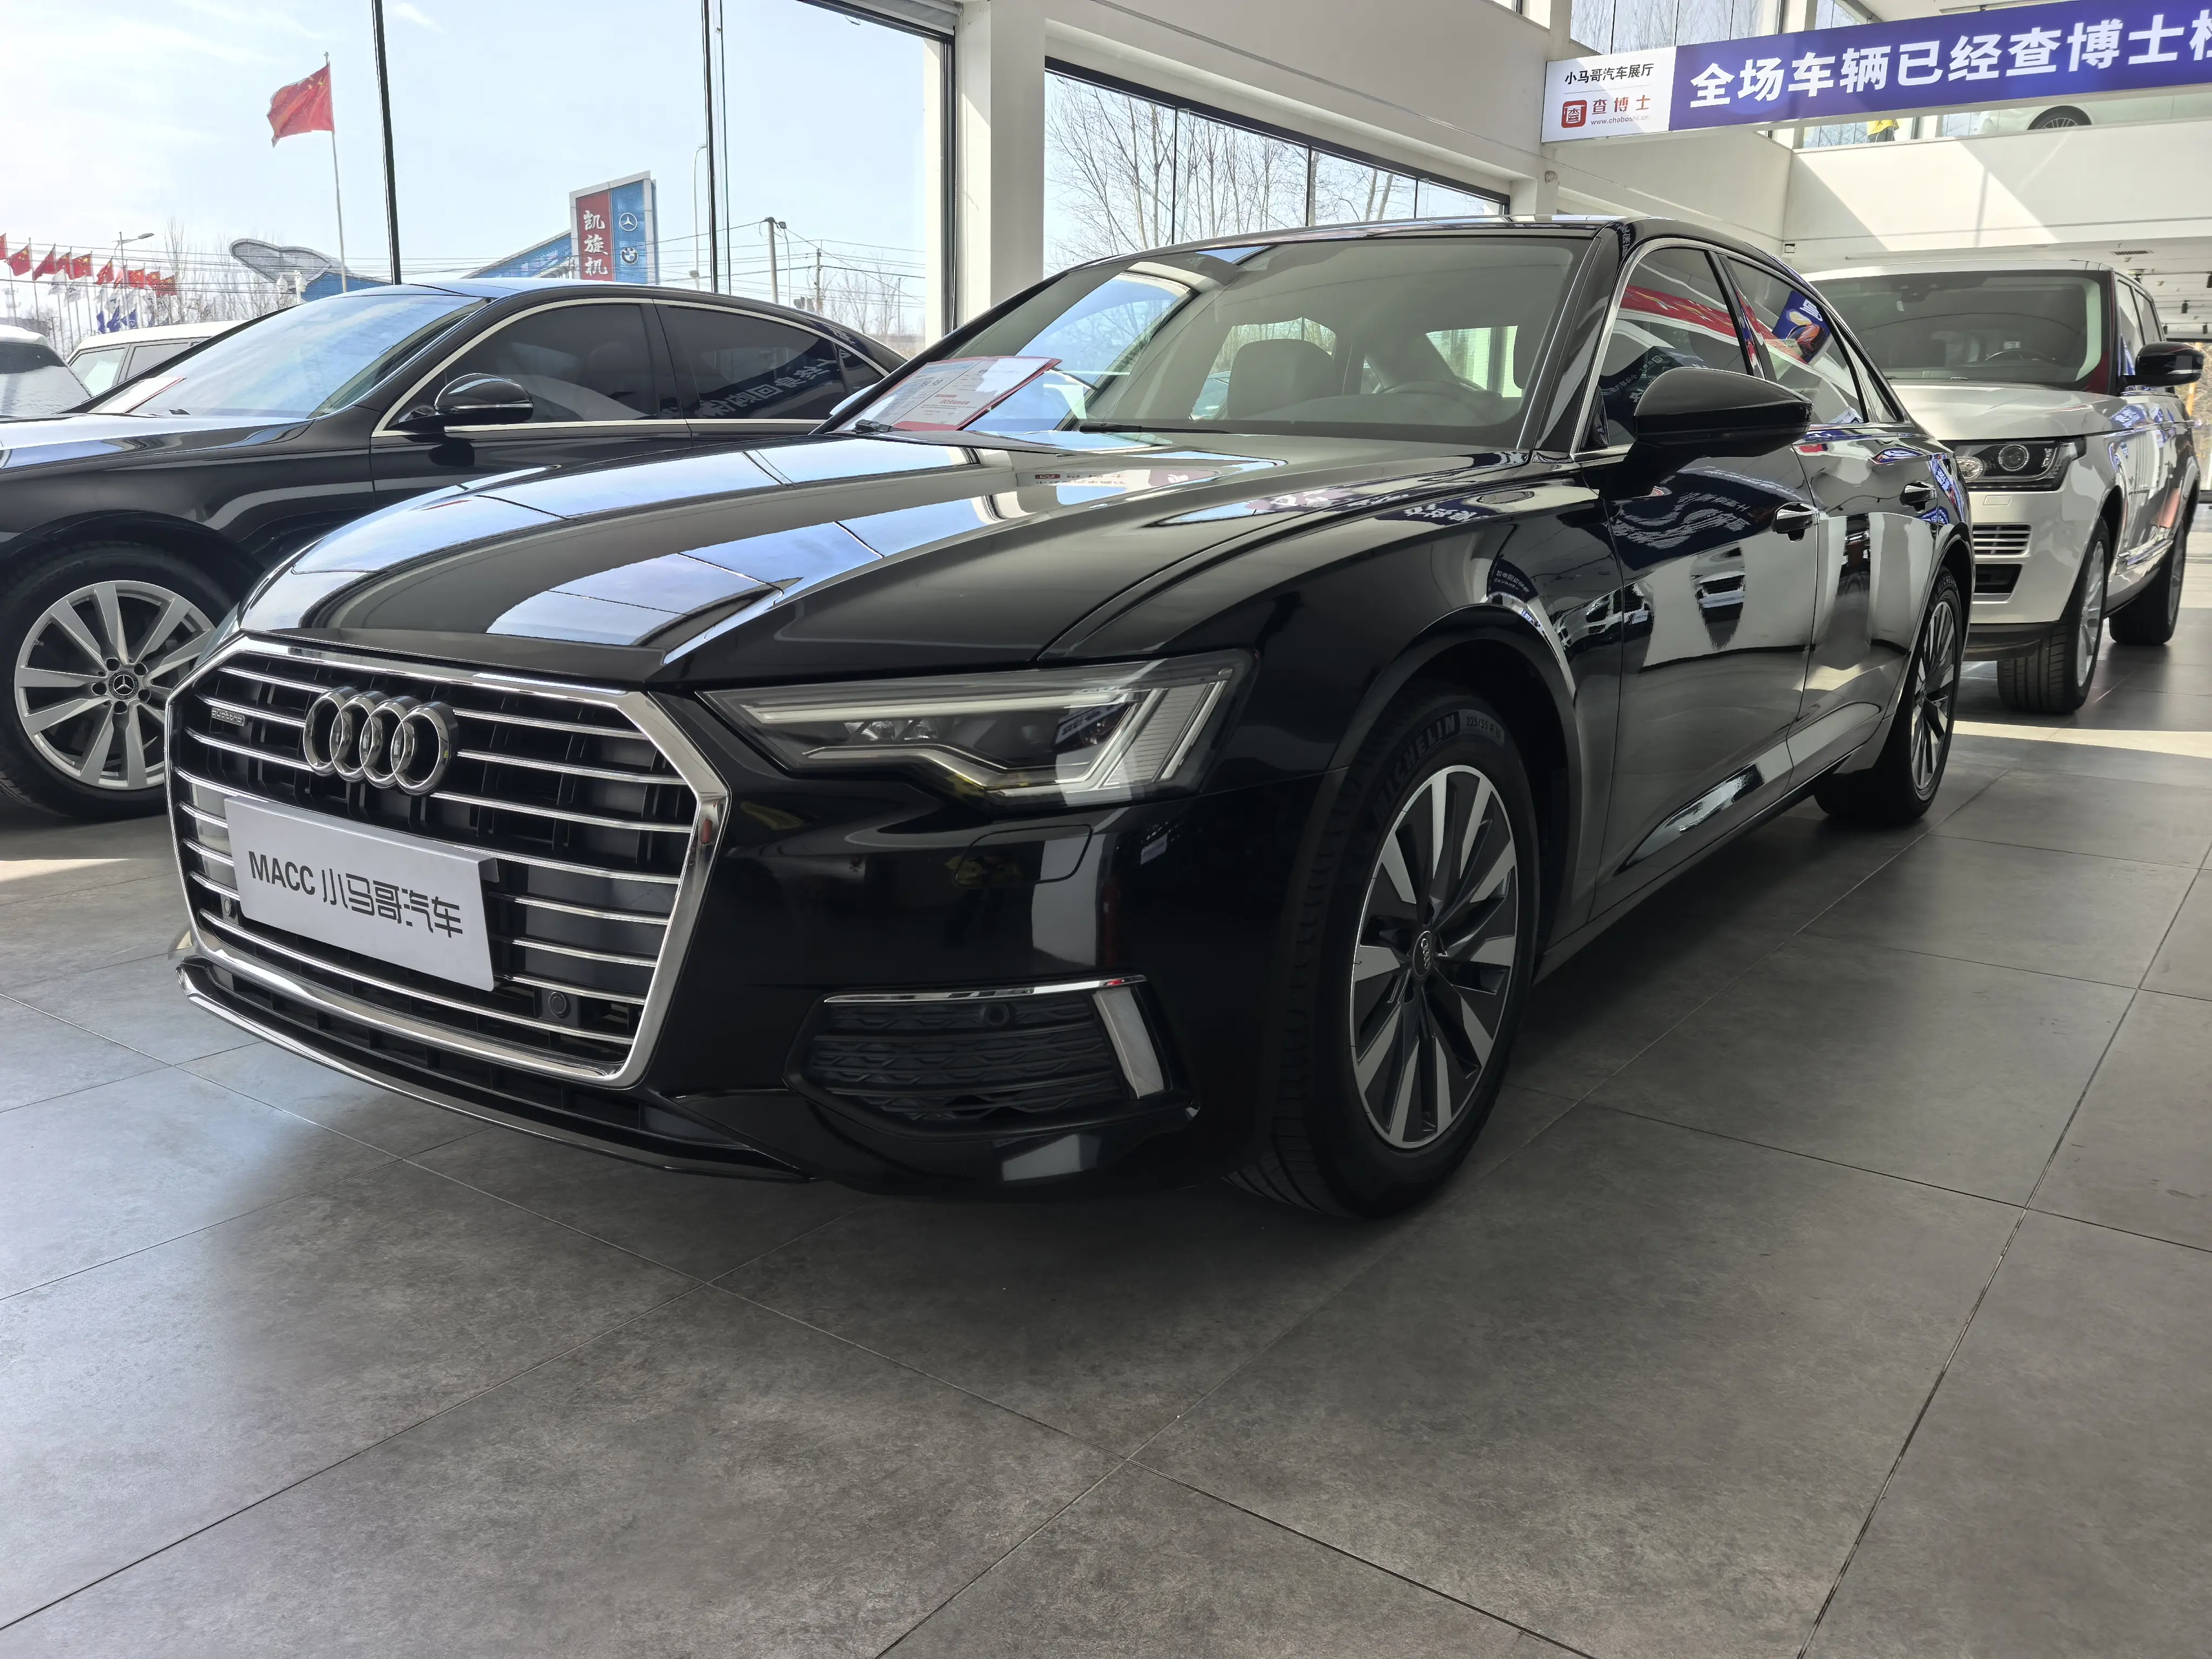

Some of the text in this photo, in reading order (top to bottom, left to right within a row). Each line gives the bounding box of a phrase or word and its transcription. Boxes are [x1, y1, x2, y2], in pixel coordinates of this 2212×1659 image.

[1564, 64, 1654, 84] 小马哥汽车展厅
[1592, 95, 1651, 114] 查博士
[1591, 116, 1649, 125] www.chaboshi.cn
[583, 210, 608, 276] 凯旋机
[212, 710, 242, 723] quattro
[1373, 714, 1455, 824] MICHELIN
[248, 851, 464, 939] MACC 小马哥汽车
